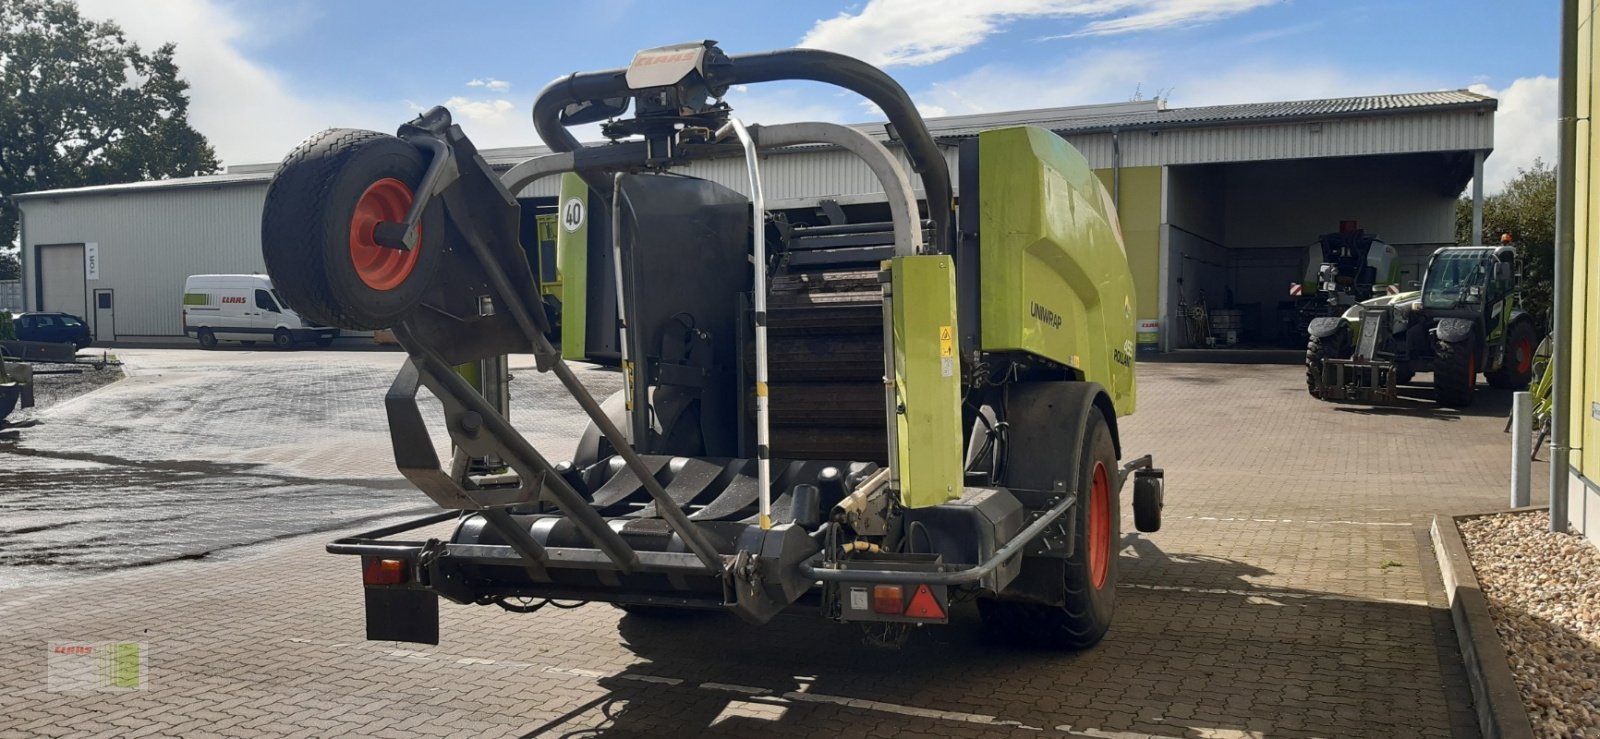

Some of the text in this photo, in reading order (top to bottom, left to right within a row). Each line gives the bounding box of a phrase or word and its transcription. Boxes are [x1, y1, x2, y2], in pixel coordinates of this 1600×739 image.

[635, 51, 696, 67] CLAAS
[566, 203, 581, 226] 40
[221, 296, 247, 304] CLAAS
[1030, 301, 1062, 330] UNIWRAP
